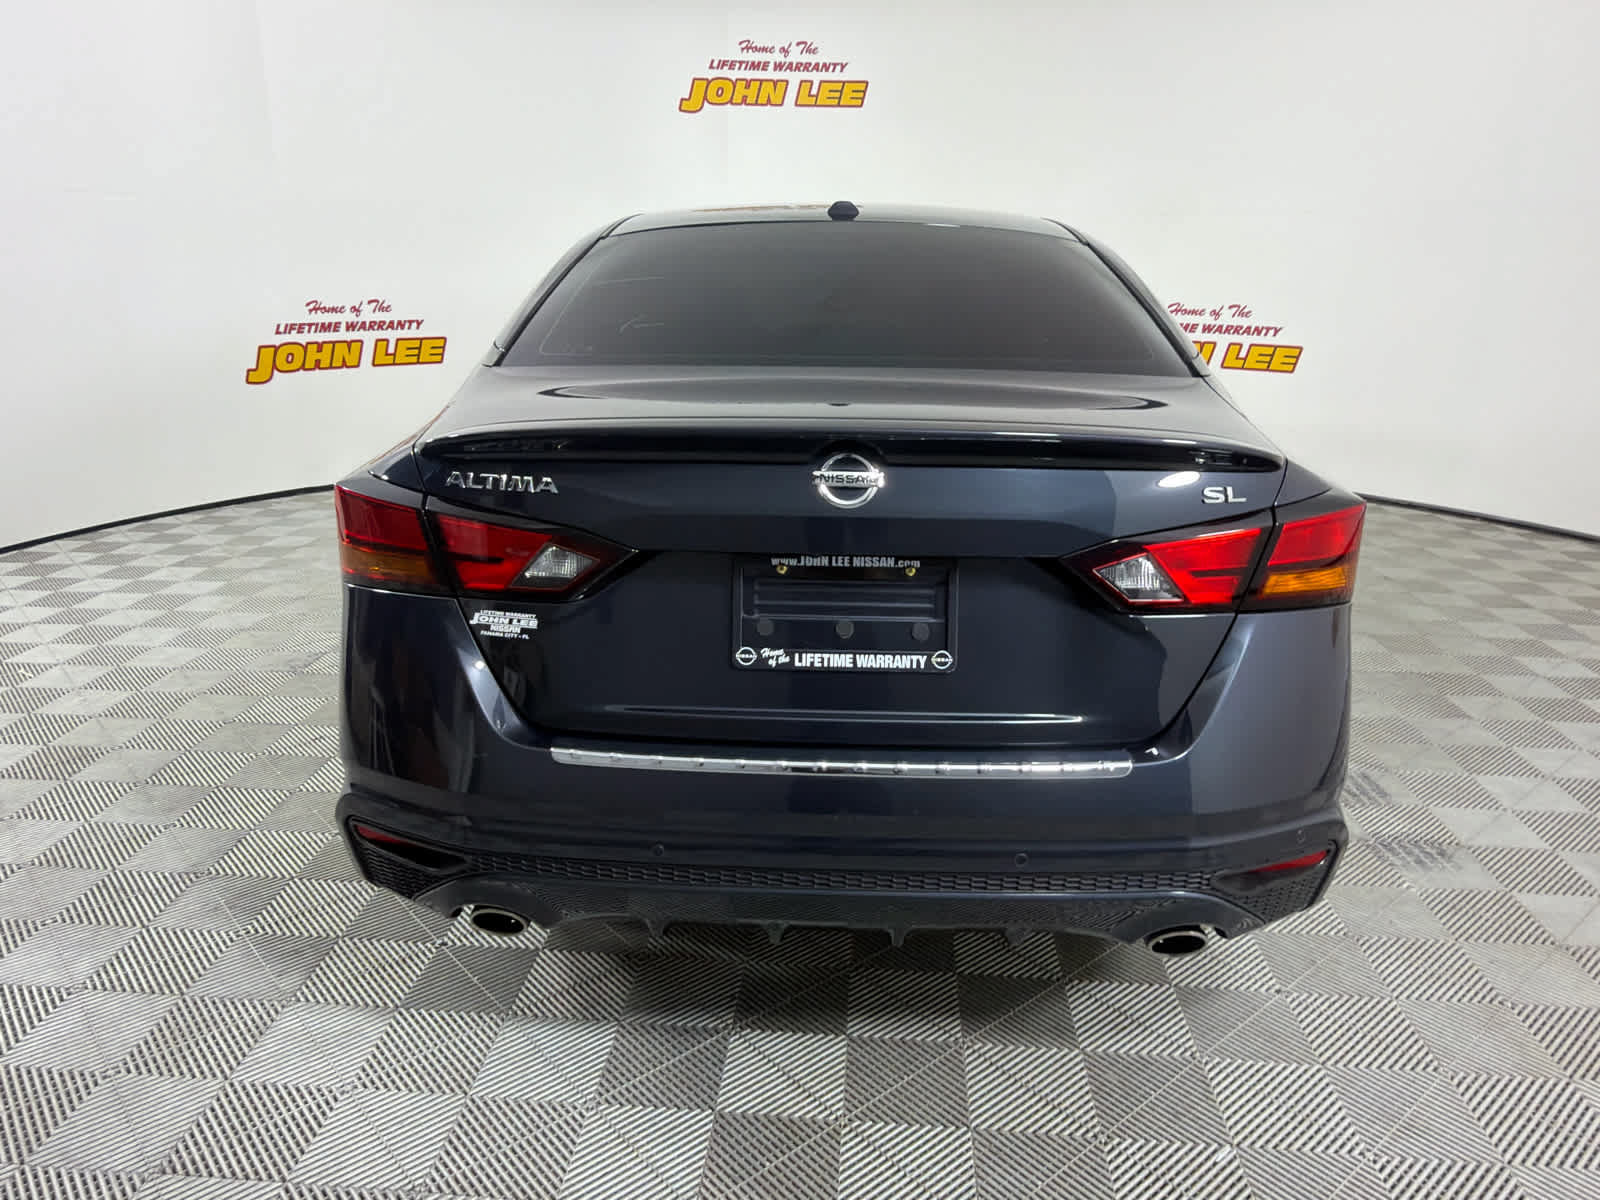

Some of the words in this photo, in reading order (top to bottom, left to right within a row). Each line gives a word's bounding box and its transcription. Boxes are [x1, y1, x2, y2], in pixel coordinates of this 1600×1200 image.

[738, 40, 775, 55] Home
[779, 44, 792, 58] of
[796, 41, 819, 55] The
[709, 59, 770, 72] LIFETIME
[773, 61, 848, 73] WARRANTY
[679, 77, 789, 113] JOHN
[795, 80, 869, 107] LEE
[305, 300, 346, 315] Home
[350, 302, 363, 317] of
[367, 299, 392, 314] The
[1168, 302, 1206, 316] Home
[1210, 305, 1224, 320] of
[1228, 304, 1252, 318] The
[274, 322, 341, 335] LIFETIME
[344, 319, 424, 332] WARRANTY
[1201, 323, 1283, 337] WARRANTY
[245, 339, 364, 385] JOHN
[372, 336, 447, 367] LEE
[1220, 342, 1304, 374] LEE
[445, 471, 559, 493] ALTIMA
[1202, 486, 1248, 504] SL
[831, 556, 851, 567] LEE
[469, 612, 510, 625] JOHN
[794, 652, 853, 668] LIFETIME
[855, 653, 927, 670] WARRANTY
